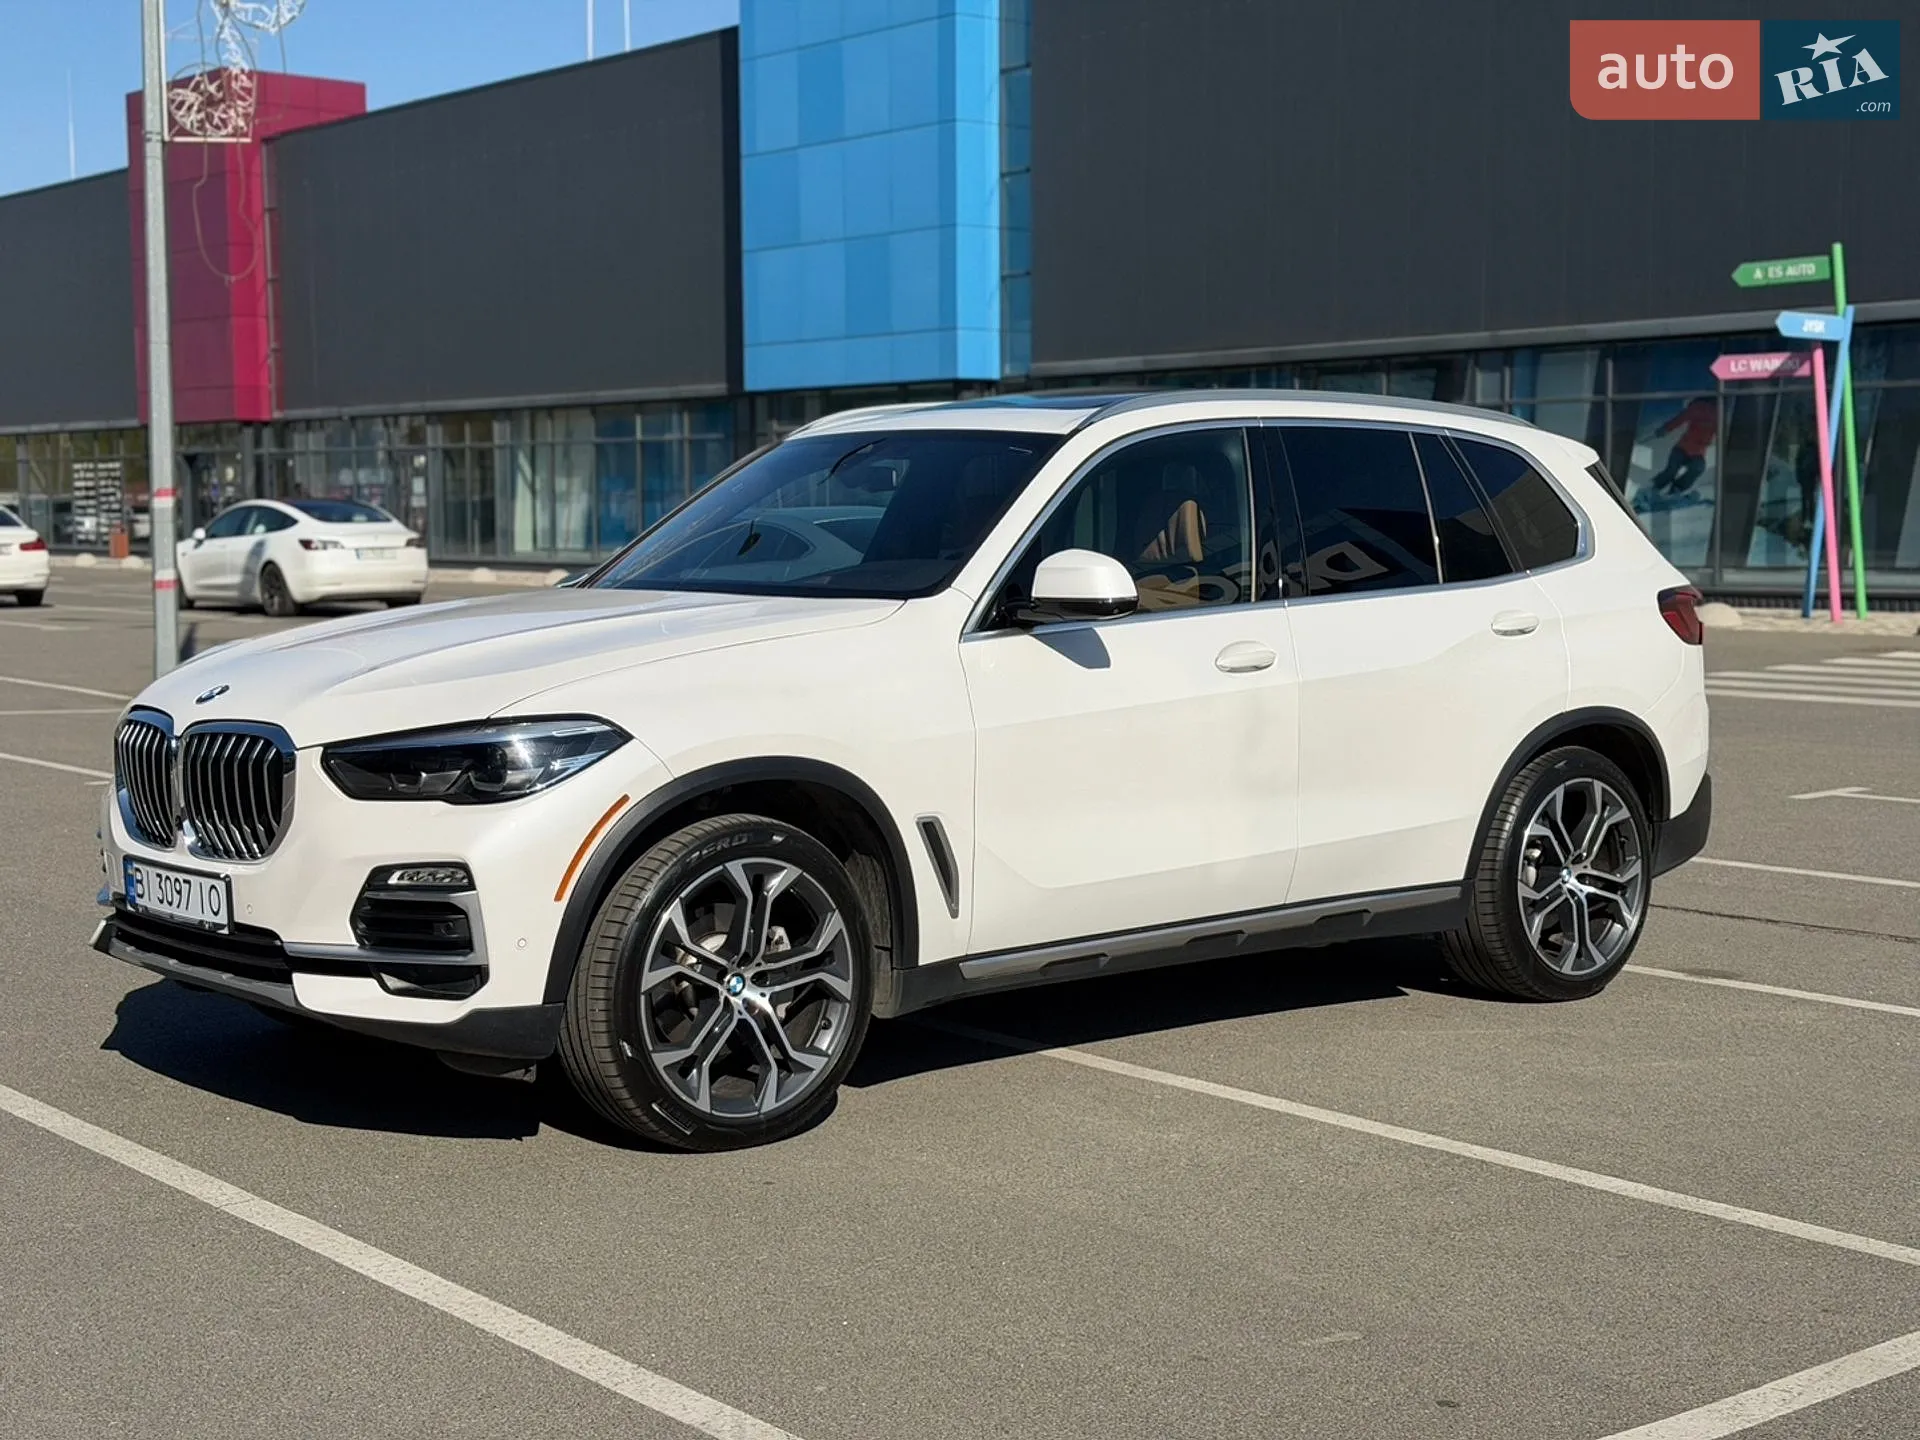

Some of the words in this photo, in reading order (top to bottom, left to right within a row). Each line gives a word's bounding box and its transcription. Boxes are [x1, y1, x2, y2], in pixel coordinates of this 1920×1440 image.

[1785, 263, 1816, 277] AUTO
[1729, 359, 1747, 374] LC
[134, 867, 151, 902] BI
[155, 872, 192, 911] 3097
[199, 882, 221, 917] IO
